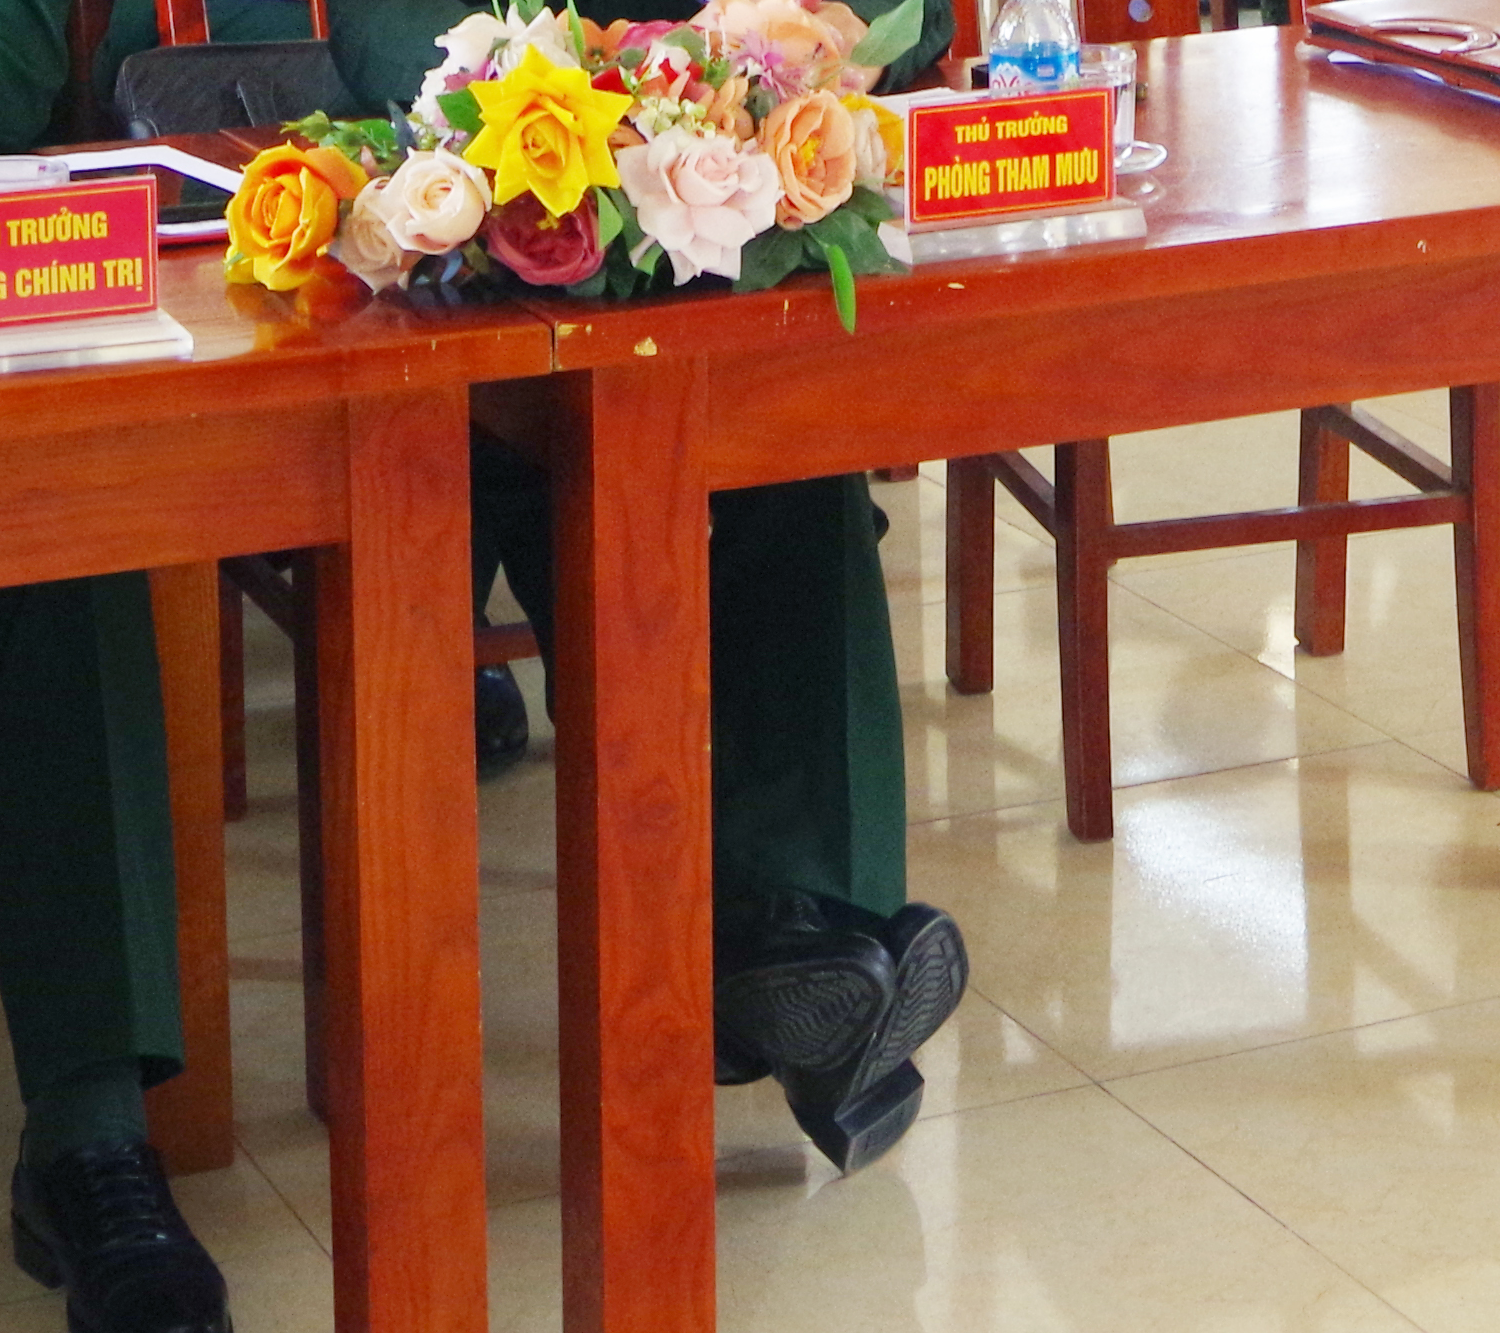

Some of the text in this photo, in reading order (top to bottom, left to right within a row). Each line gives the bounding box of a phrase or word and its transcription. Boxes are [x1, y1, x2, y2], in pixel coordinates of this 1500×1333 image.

[954, 110, 1068, 144] THỦ TRƯỞNG
[924, 147, 1099, 201] PHÒNG THAM MƯU
[6, 206, 109, 248] TRƯỞNG
[15, 259, 97, 298] CHÍNH
[102, 257, 144, 292] TRỊ
